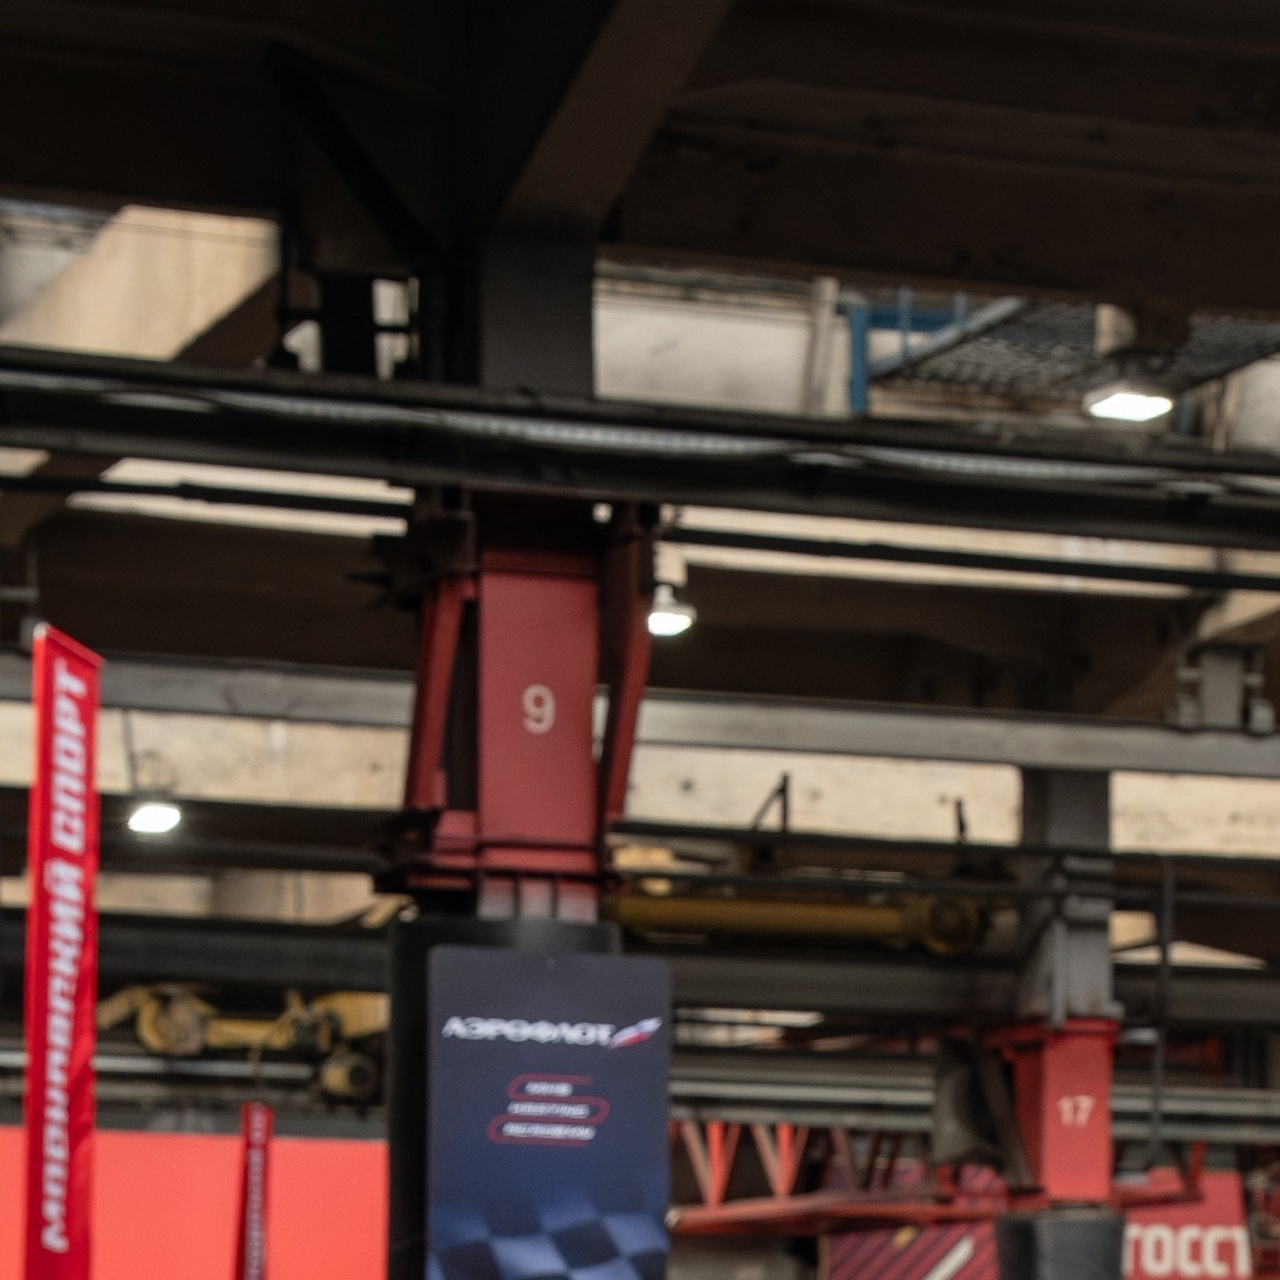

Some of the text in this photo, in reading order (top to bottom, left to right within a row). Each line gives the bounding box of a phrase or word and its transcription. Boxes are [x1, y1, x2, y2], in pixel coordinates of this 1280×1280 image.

[522, 683, 557, 735] 9
[41, 656, 87, 1253] МОСКОВСКИЙ СПОРТ
[1057, 1094, 1096, 1127] 17
